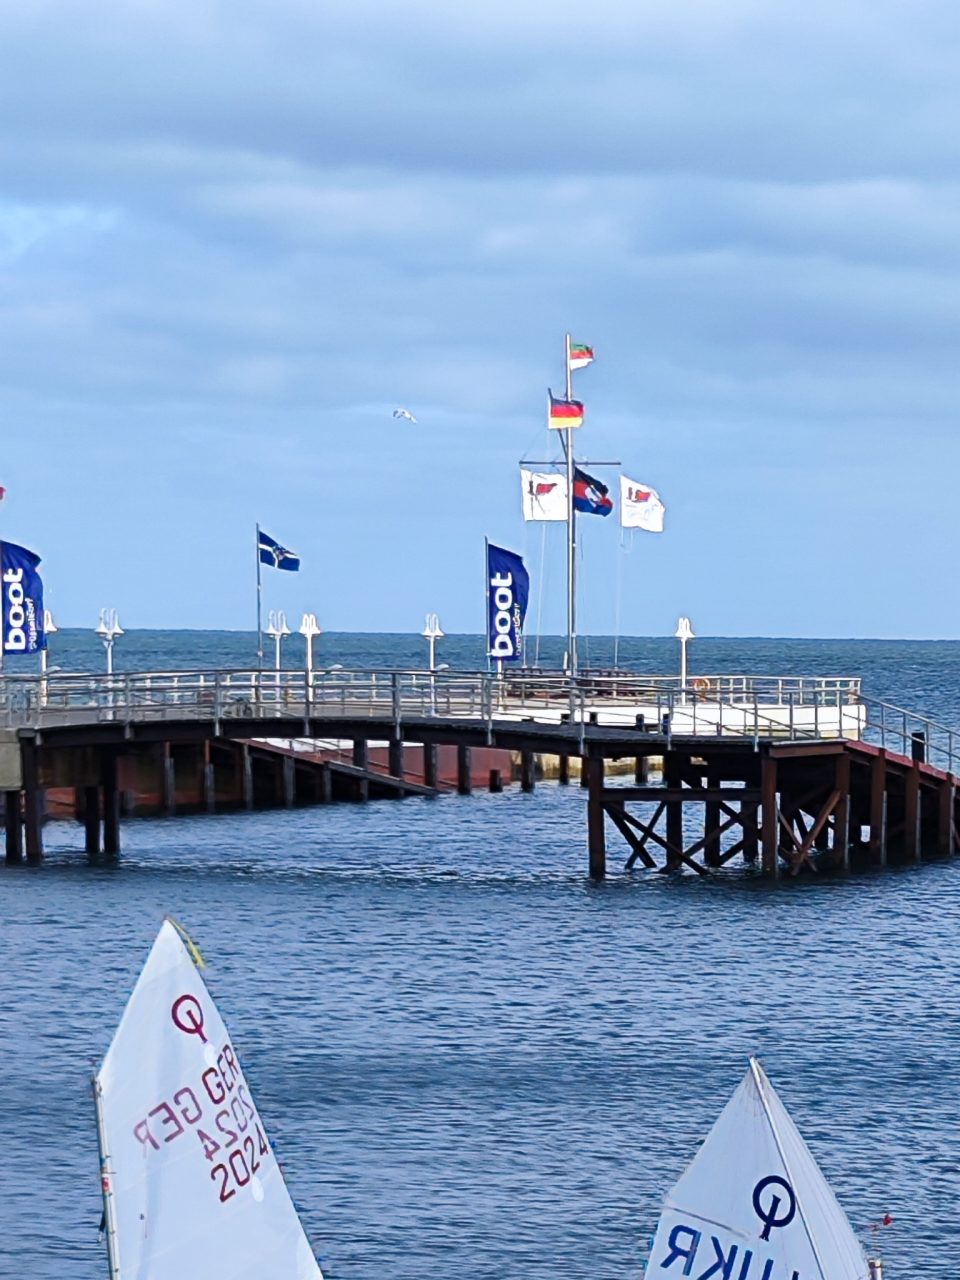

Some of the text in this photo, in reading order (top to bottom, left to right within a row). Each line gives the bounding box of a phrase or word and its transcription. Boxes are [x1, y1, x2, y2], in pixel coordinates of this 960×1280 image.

[3, 568, 26, 650] boot
[491, 572, 513, 656] boot
[202, 1044, 238, 1104] GER
[211, 1123, 268, 1202] 2024
